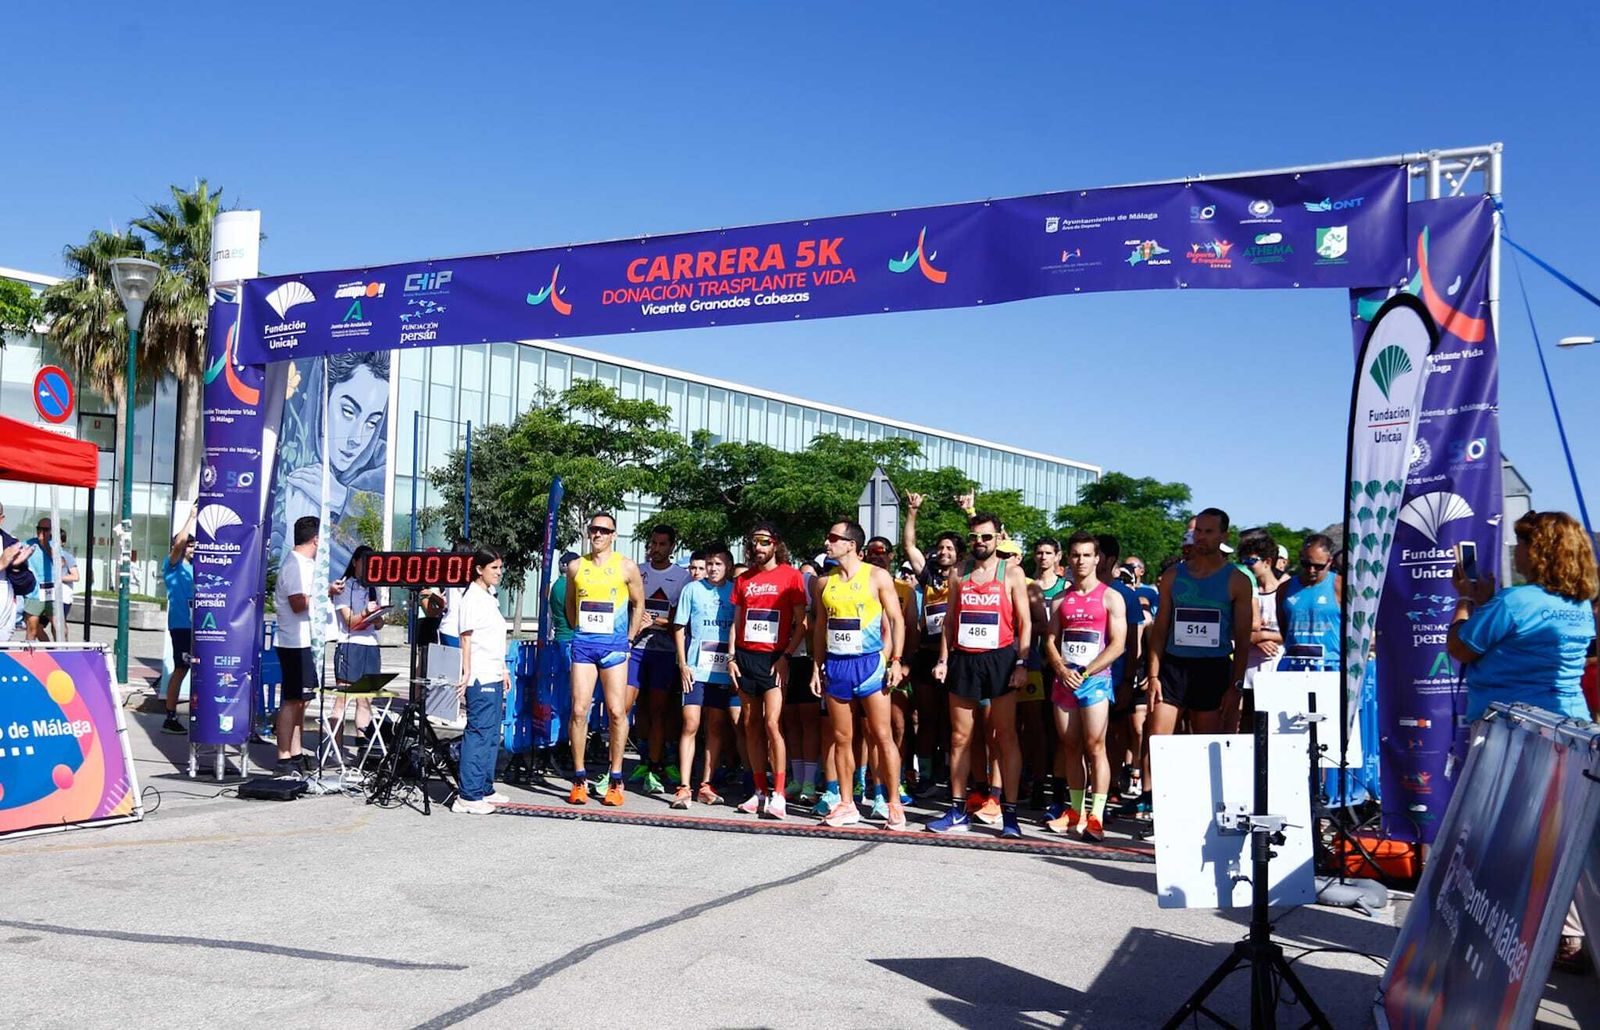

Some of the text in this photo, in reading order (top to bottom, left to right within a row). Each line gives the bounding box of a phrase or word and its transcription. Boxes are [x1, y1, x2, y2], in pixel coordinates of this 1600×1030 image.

[1333, 197, 1364, 210] ONT
[1062, 216, 1116, 225] Ayuntamiento
[1129, 212, 1158, 220] Málaga
[1242, 245, 1294, 256] ATHEMA
[627, 237, 844, 283] CARRERA 5K
[602, 268, 856, 305] DONACIÓN TRASPLANTE VIDA
[641, 292, 810, 316] Vicente Granados Cabezas
[264, 320, 306, 334] Fundación
[402, 322, 439, 331] FUNDACIÓN
[269, 335, 298, 349] Unicaja
[400, 328, 437, 344] persán
[1461, 349, 1483, 359] Vida
[1368, 406, 1410, 422] Fundación
[1446, 407, 1459, 415] de
[216, 416, 234, 424] Málaga
[1374, 428, 1402, 443] Unicaja
[194, 541, 241, 551] Fundación
[200, 554, 232, 566] Unicaja
[1411, 564, 1456, 580] Unica
[195, 598, 226, 609] persán
[961, 593, 1000, 606] KENYA
[587, 614, 604, 623] 643
[1541, 609, 1585, 621] CARRERA
[752, 622, 768, 632] 464
[968, 626, 987, 637] 486
[1187, 624, 1208, 635] 514
[834, 632, 851, 642] 646
[1413, 633, 1448, 647] pers
[1069, 644, 1087, 654] 619
[8, 721, 29, 739] de
[32, 718, 92, 738] Málaga
